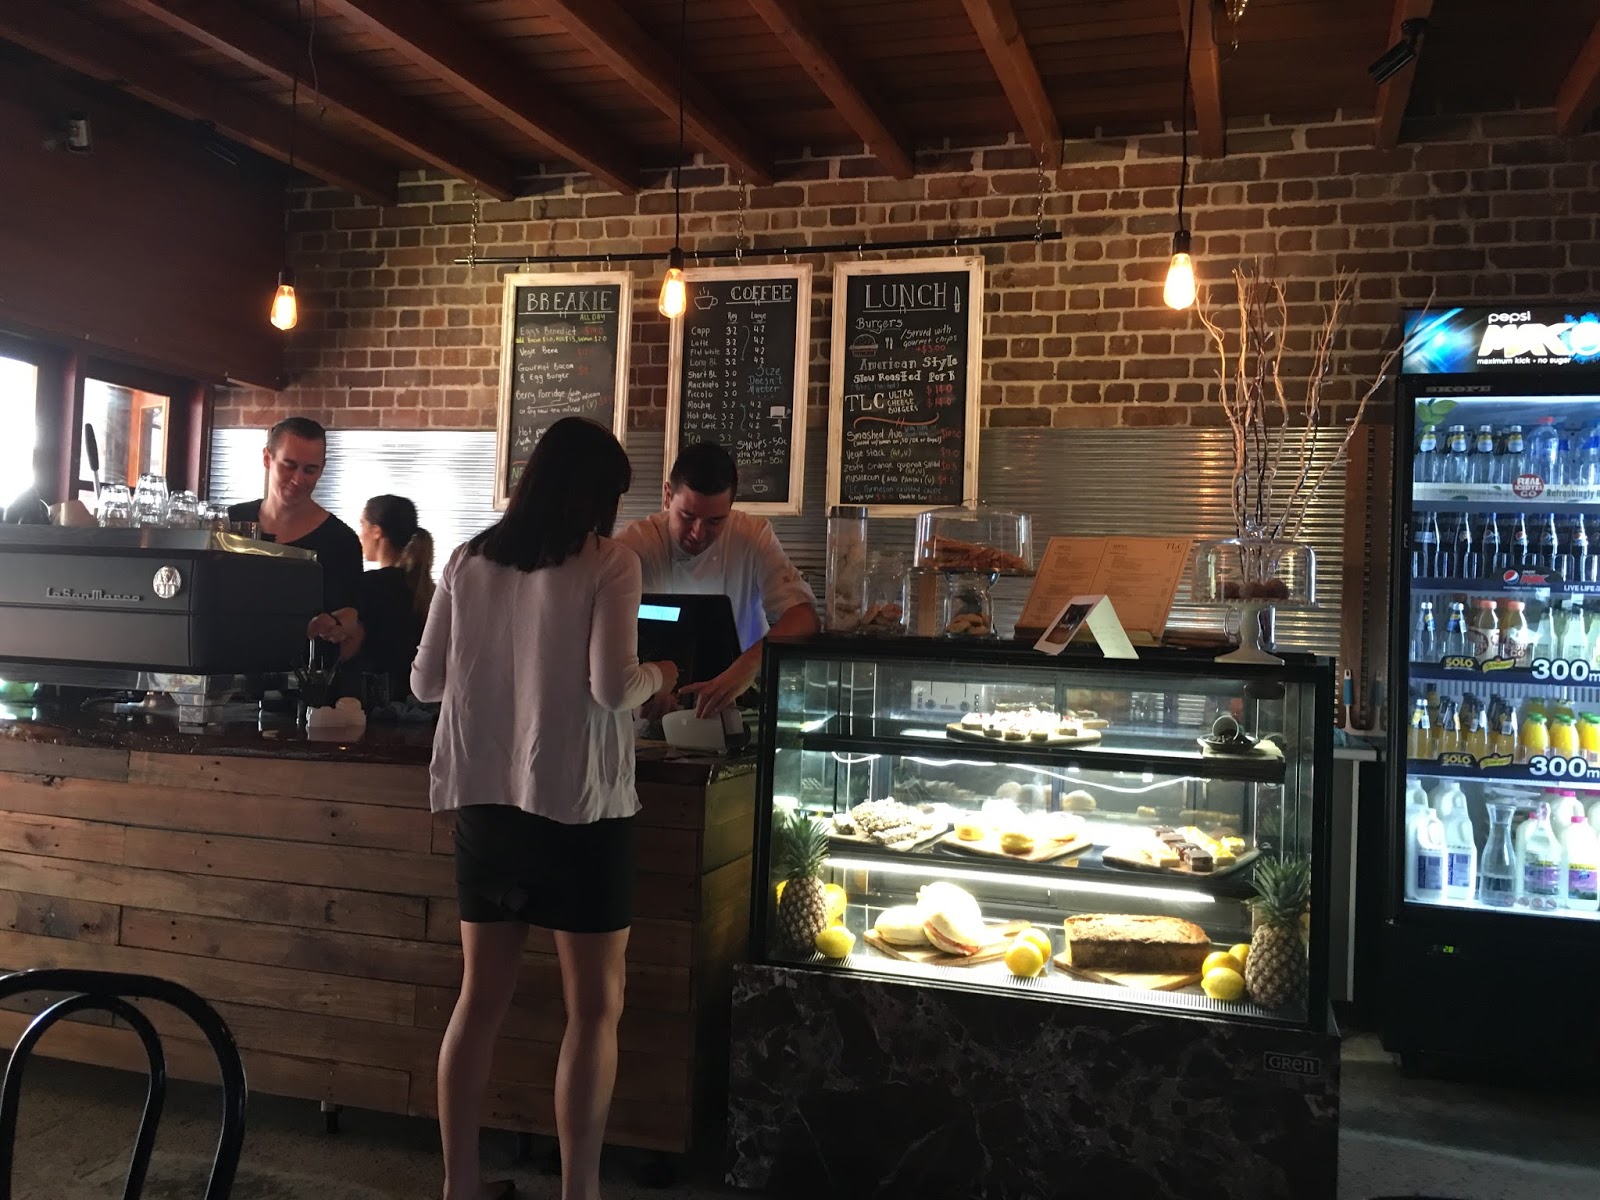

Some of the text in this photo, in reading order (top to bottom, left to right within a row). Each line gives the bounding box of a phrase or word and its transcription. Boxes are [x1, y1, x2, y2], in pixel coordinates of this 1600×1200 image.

[731, 285, 792, 300] COFFEE
[865, 282, 947, 308] LUNCH
[527, 291, 612, 311] BREAKIE
[592, 313, 606, 321] DAY
[727, 311, 767, 322] Reg Large
[1488, 311, 1531, 324] pepsi
[855, 317, 903, 334] Burgers
[934, 324, 952, 335] with
[520, 326, 576, 336] Eggs Benedict
[691, 326, 710, 337] Capp
[691, 339, 709, 347] Latte
[935, 334, 957, 344] chips
[690, 359, 706, 370] Long
[859, 354, 958, 372] American Style
[1549, 357, 1572, 366] sugar
[530, 374, 543, 384] Egg
[547, 373, 570, 382] Burger
[688, 370, 707, 379] Short
[853, 370, 956, 384] Slow Roasted Pork
[688, 381, 719, 389] Macchiato
[746, 385, 780, 395] Matter
[516, 388, 565, 404] Berry Porridge
[687, 390, 713, 398] Piccolo
[888, 389, 914, 399] ULTRA
[687, 402, 711, 410] Mocha
[845, 393, 885, 412] TLC
[887, 398, 914, 407] CHEESE
[888, 405, 919, 414] BURGERS
[687, 412, 699, 420] Hot
[518, 426, 532, 436] Hot
[847, 429, 884, 442] Smashed
[684, 432, 701, 444] Tea
[1517, 477, 1541, 485] REAL
[1563, 584, 1579, 592] LIVE
[1446, 658, 1474, 668] SOLO
[1443, 755, 1471, 764] SOLO
